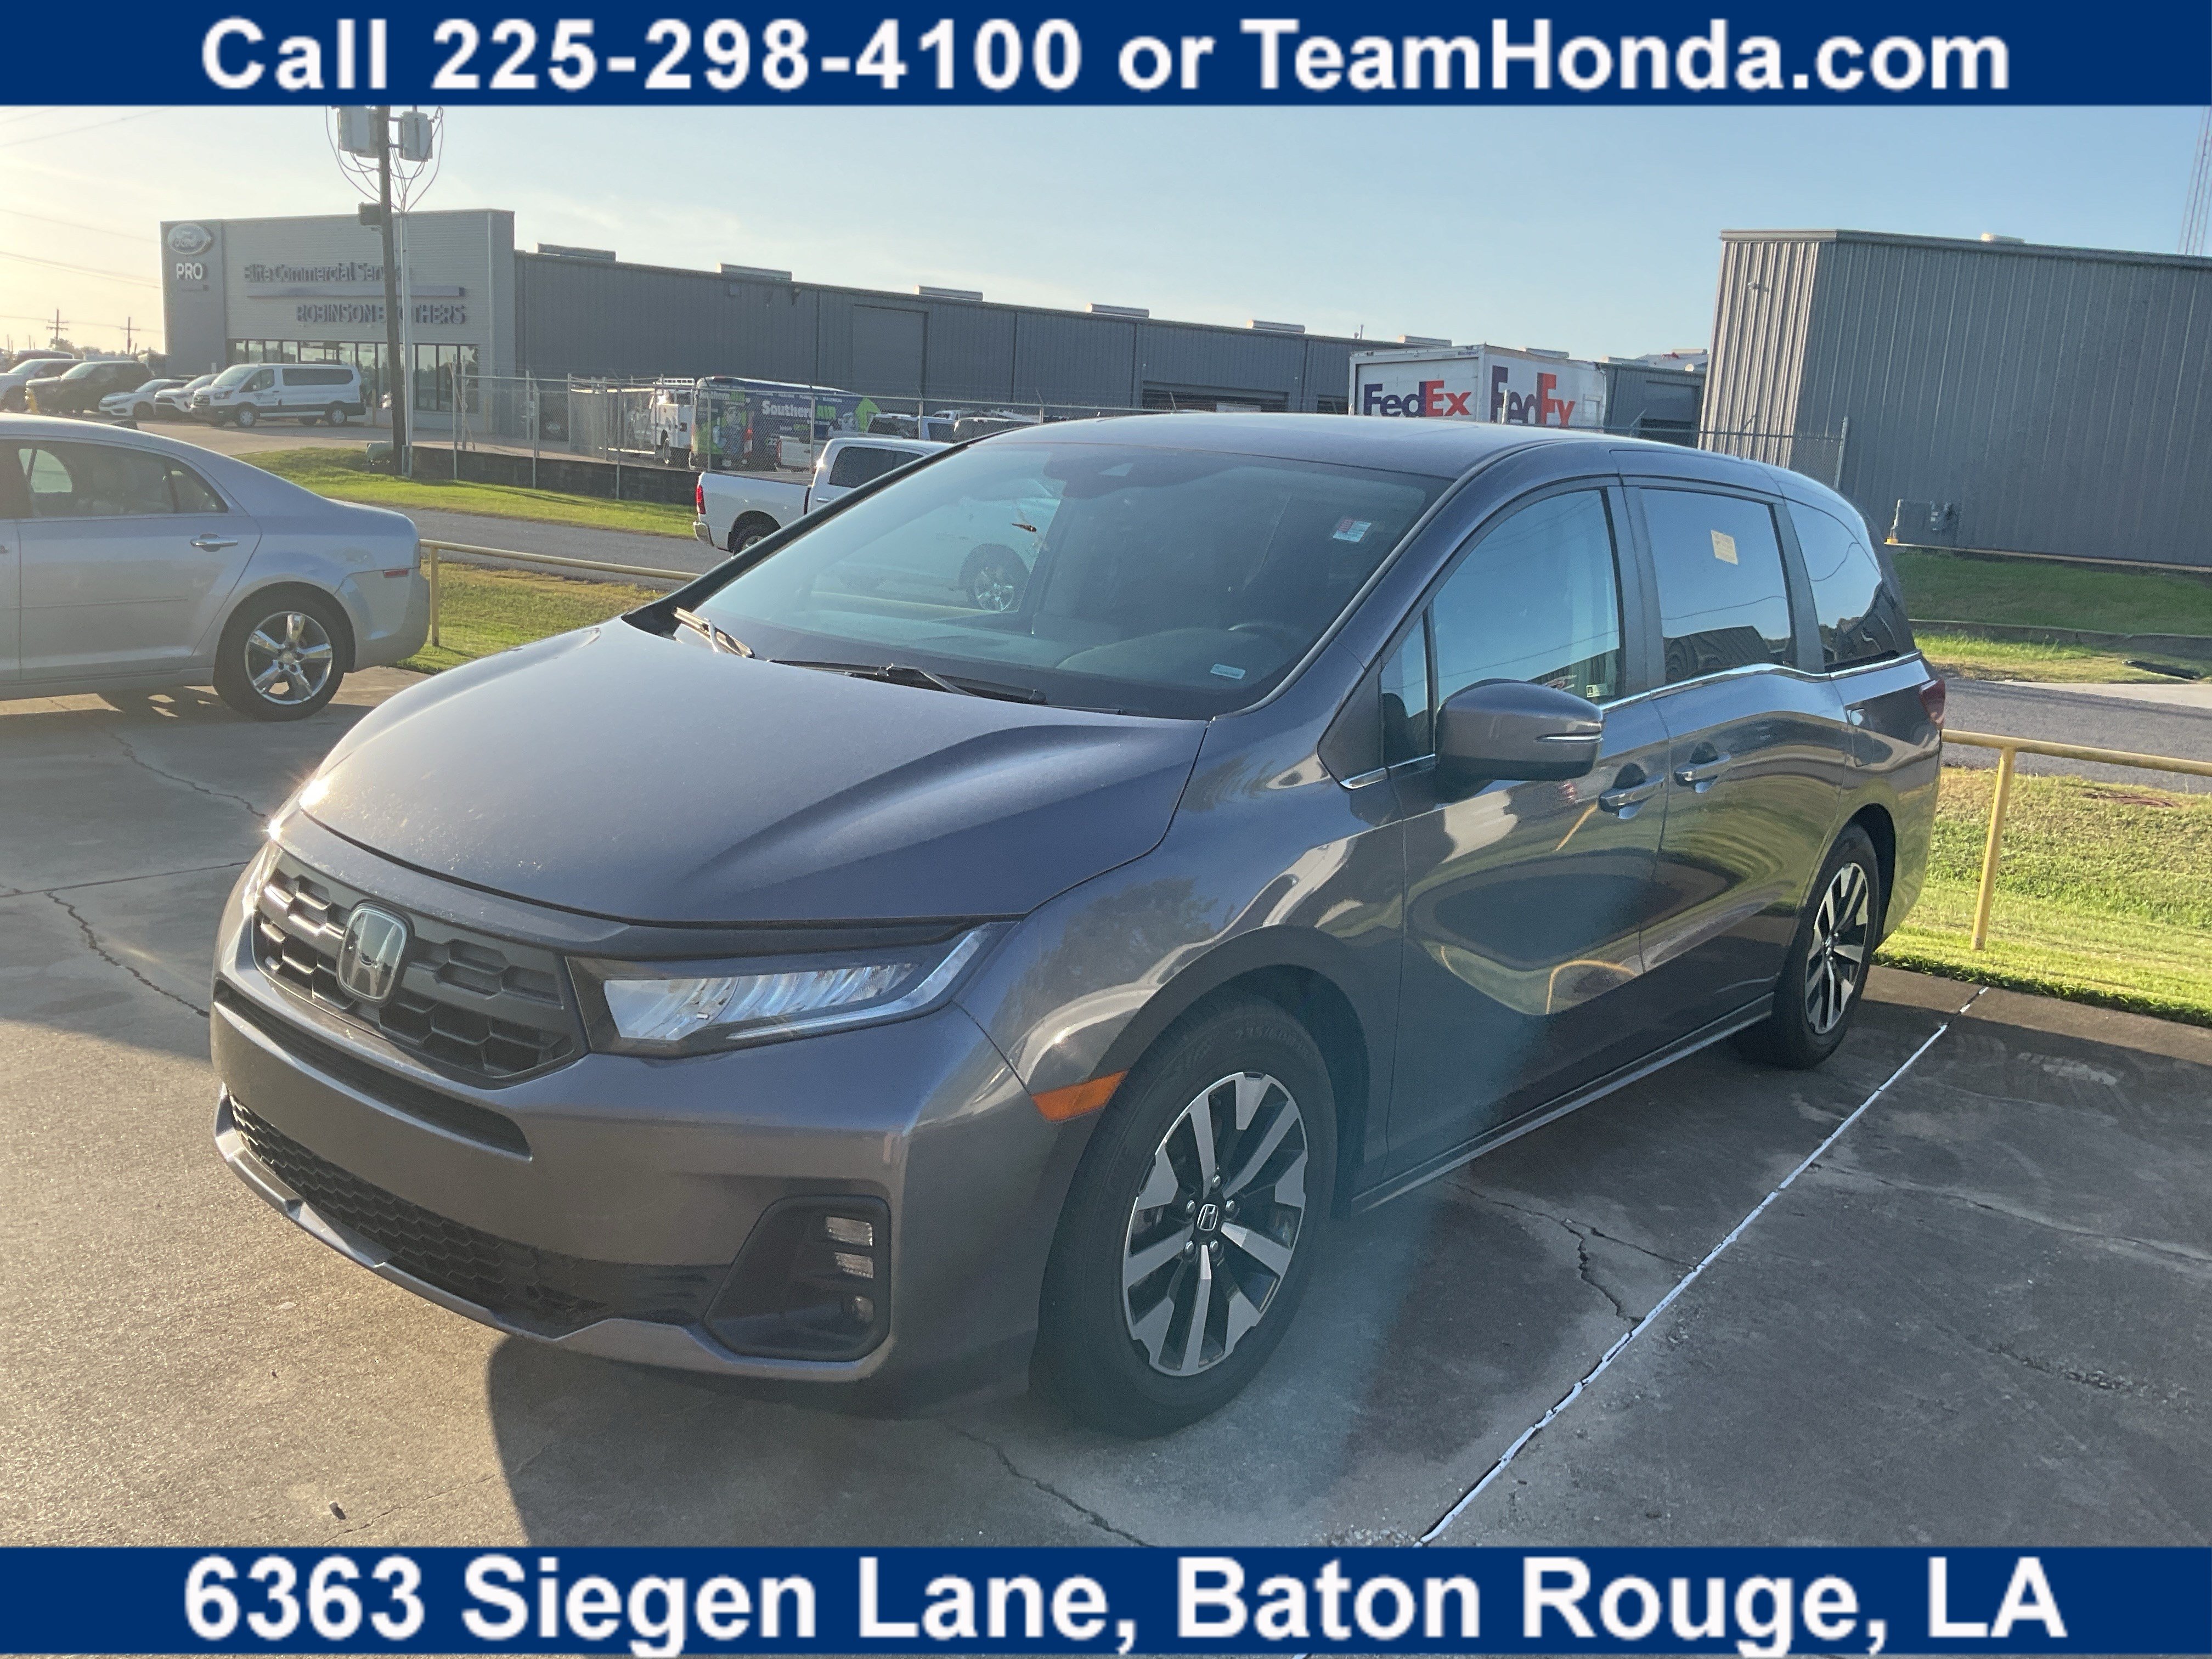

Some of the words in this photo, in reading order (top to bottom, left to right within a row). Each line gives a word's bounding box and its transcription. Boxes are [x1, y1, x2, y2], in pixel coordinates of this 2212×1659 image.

[176, 263, 203, 280] PRO
[244, 263, 274, 282] Elite
[274, 262, 357, 282] Commercial
[296, 303, 376, 323] ROBINSON
[1363, 380, 1472, 417] FedEx
[761, 400, 813, 418] Southern
